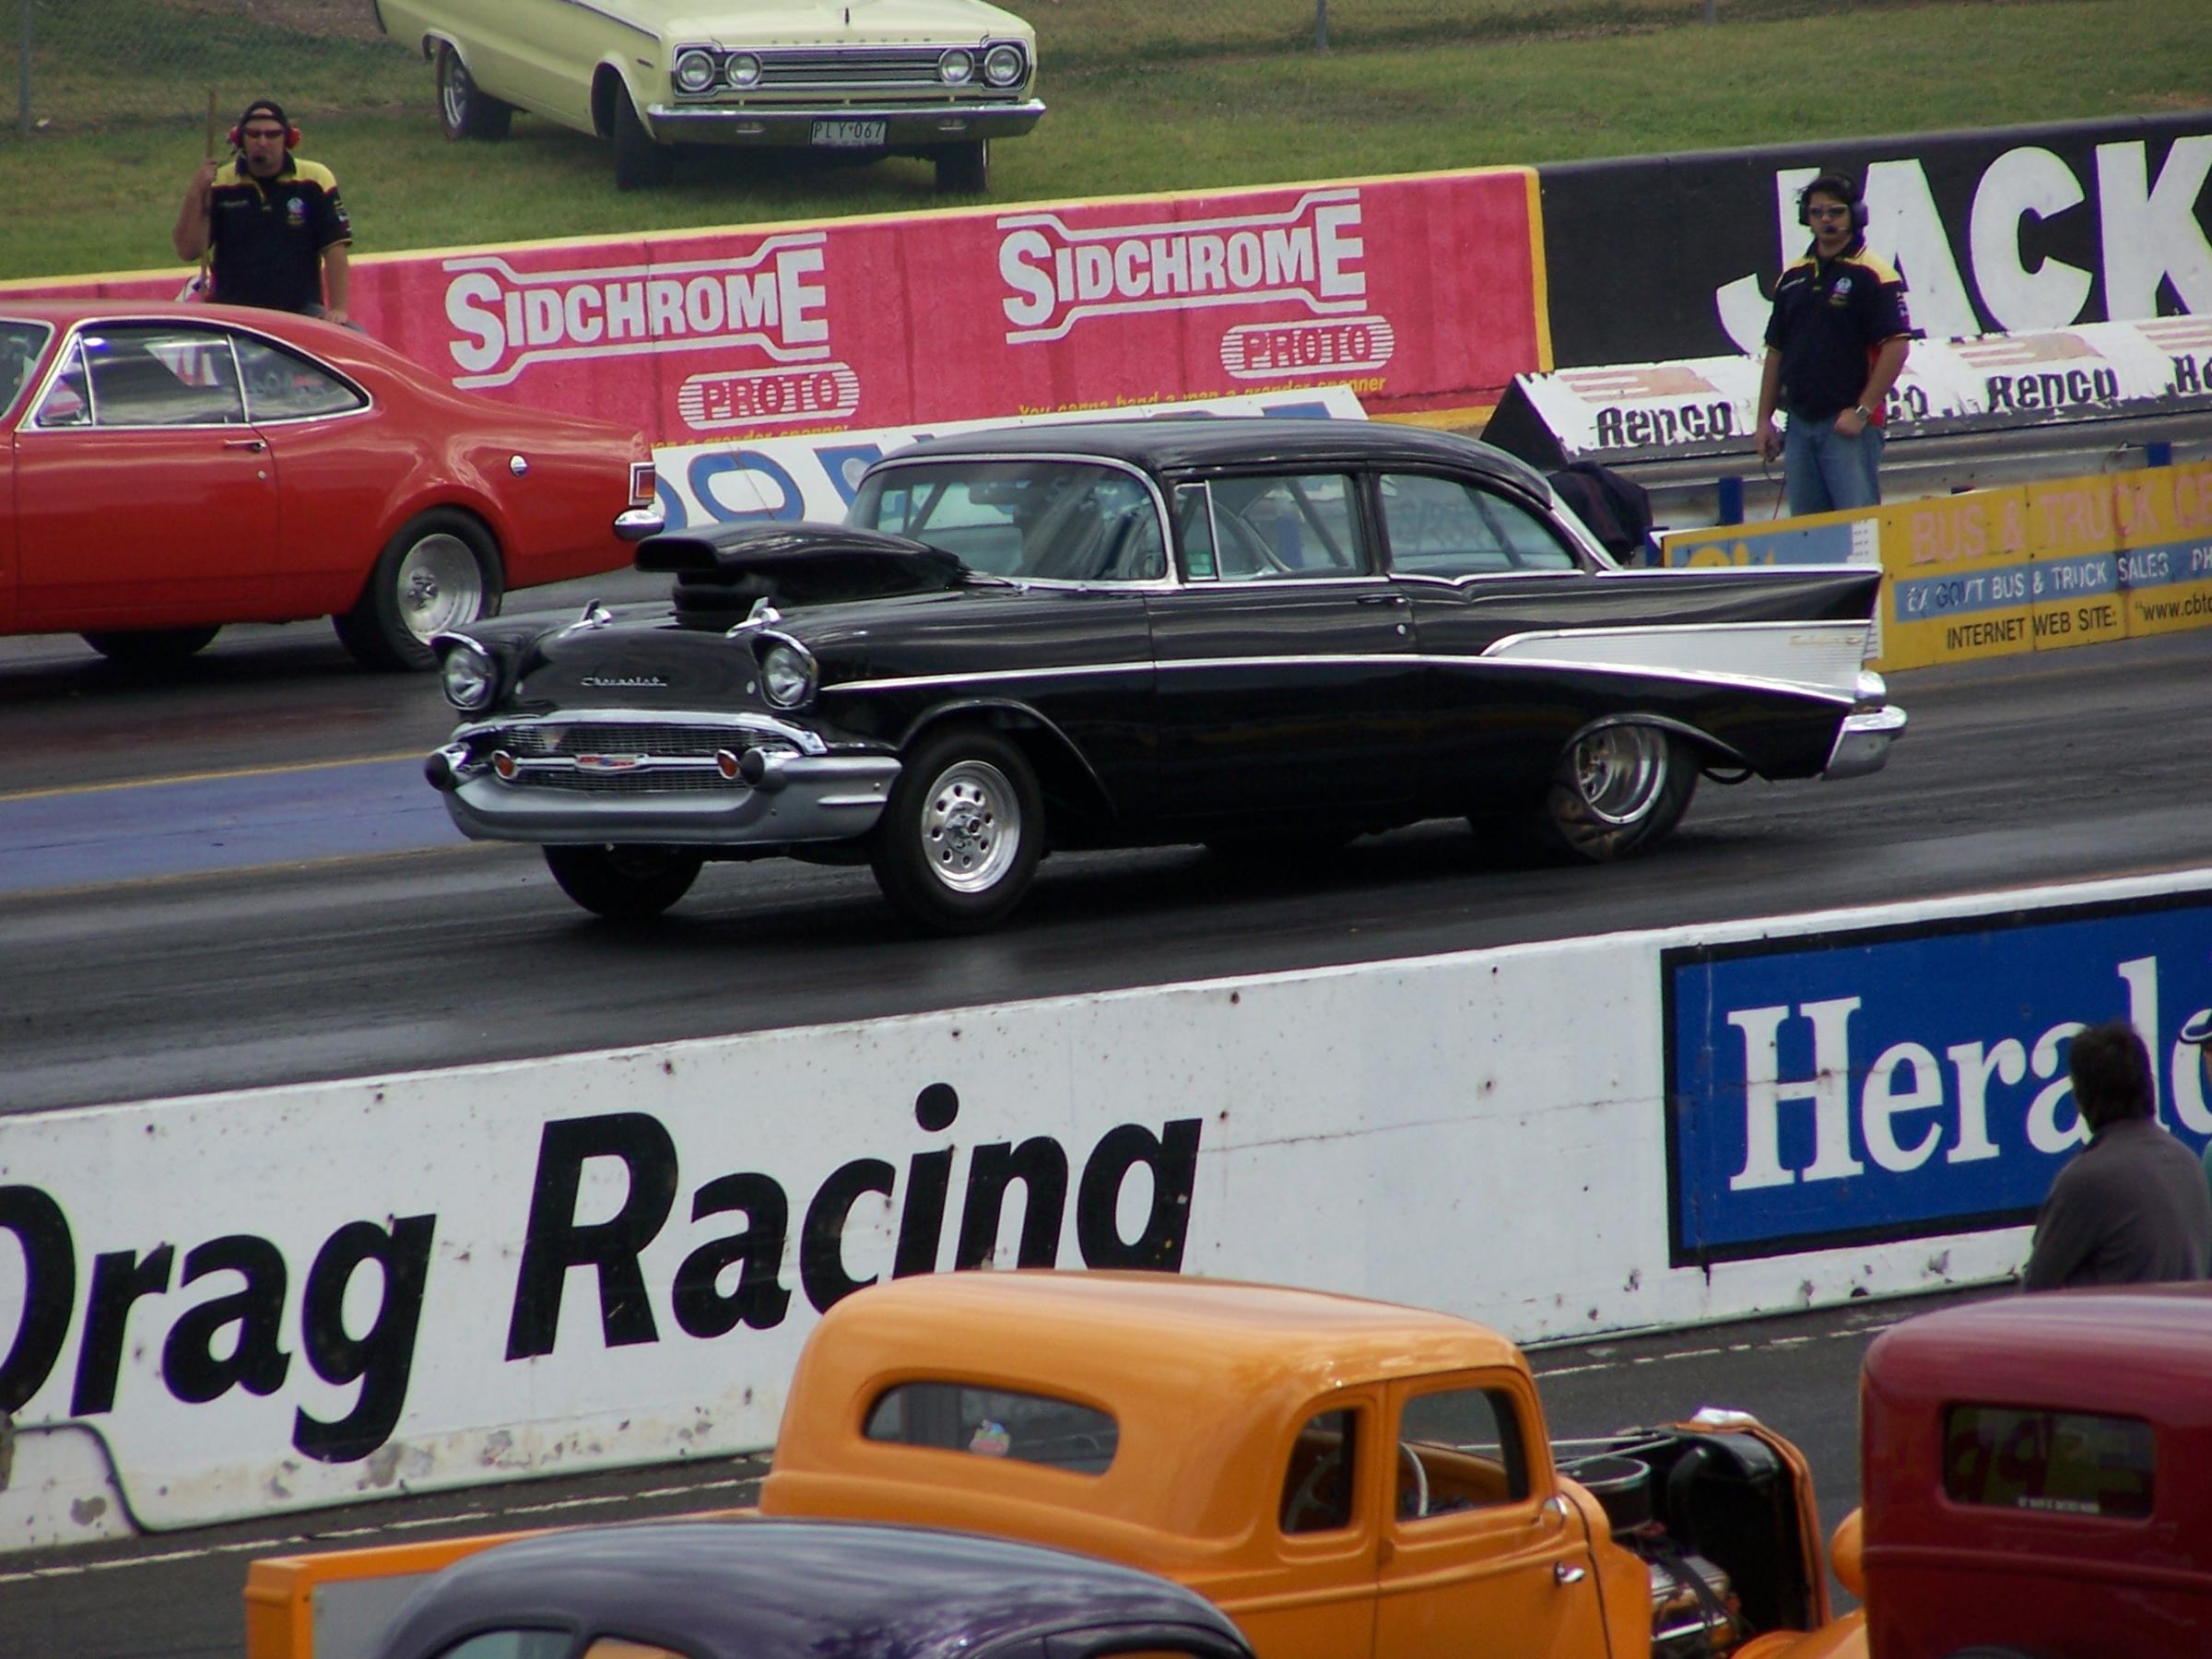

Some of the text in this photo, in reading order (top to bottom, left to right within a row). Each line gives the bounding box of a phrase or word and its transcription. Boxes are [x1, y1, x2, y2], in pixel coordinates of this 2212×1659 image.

[999, 204, 1367, 325] SIDCHROME
[1716, 135, 2212, 357] JACK
[445, 248, 829, 371] SIDCHROME
[1241, 324, 1372, 370] PROTO
[702, 372, 841, 420] PROTO
[1912, 504, 1986, 563] BUS
[1999, 499, 2026, 552] &
[2034, 481, 2160, 548] TRUCK
[1993, 572, 2026, 599] BUS
[2033, 571, 2044, 594] &
[2051, 560, 2108, 590] TRUCK
[2118, 551, 2170, 582] SALES
[1947, 618, 2026, 651] INTERNET
[2032, 611, 2071, 637] WEB
[2078, 605, 2117, 631] SITE:
[505, 1082, 1204, 1362] Racing
